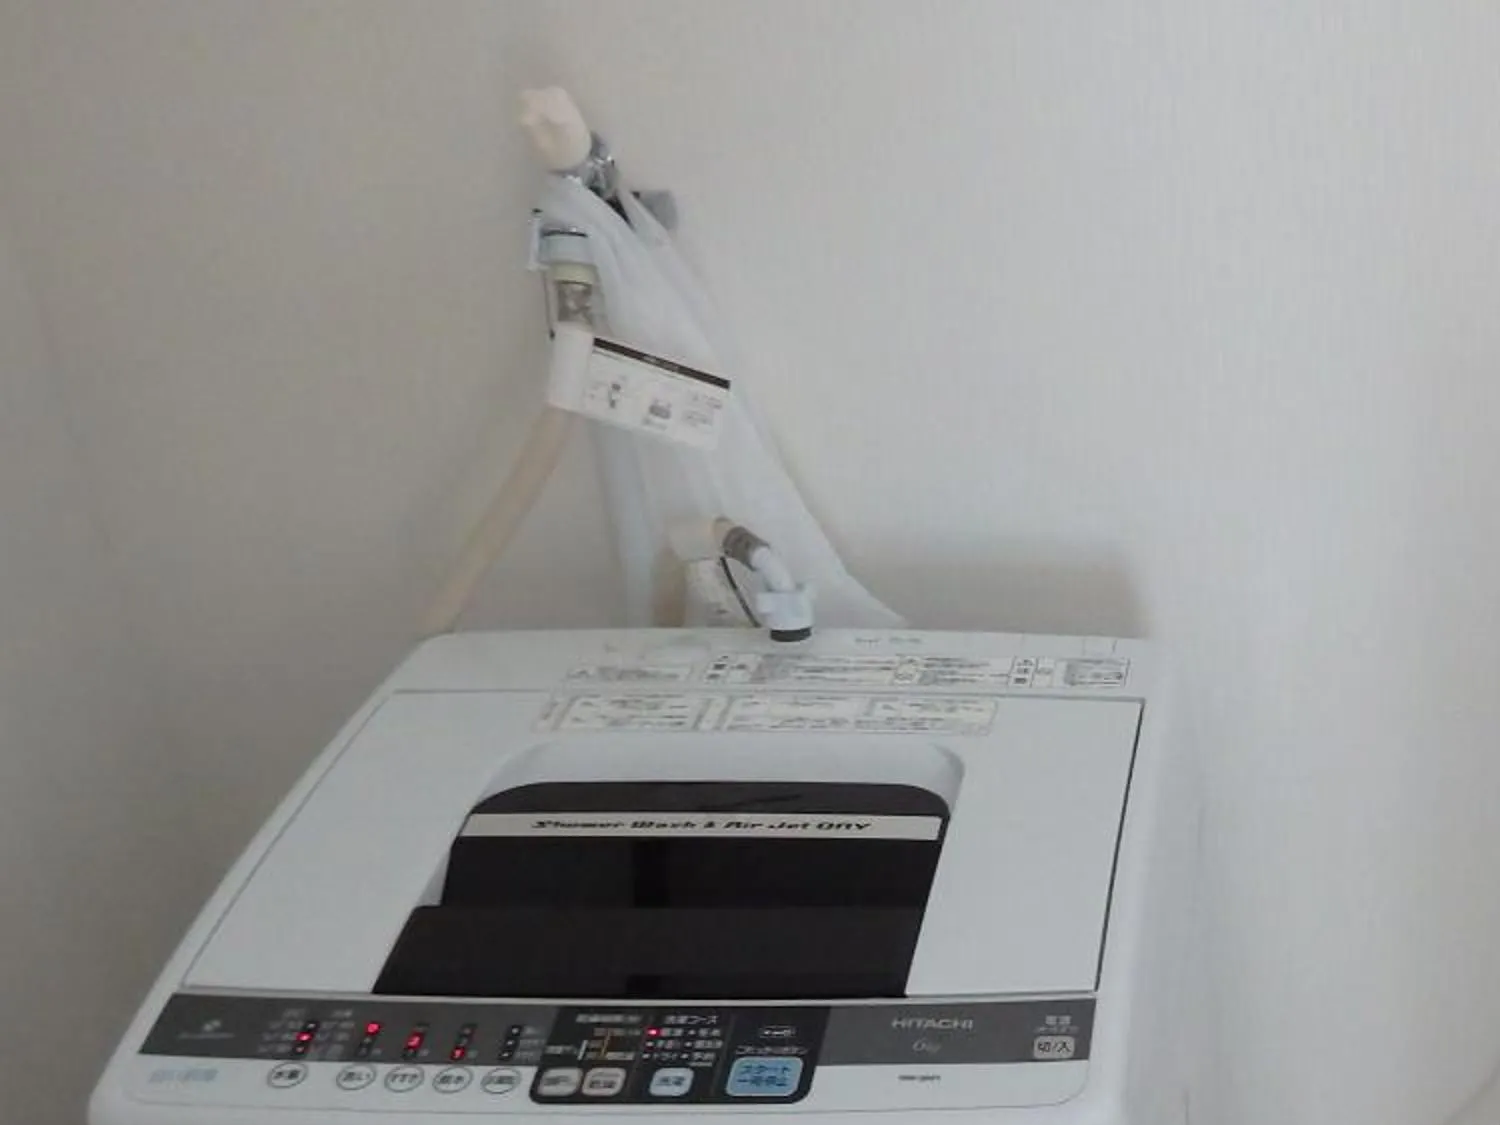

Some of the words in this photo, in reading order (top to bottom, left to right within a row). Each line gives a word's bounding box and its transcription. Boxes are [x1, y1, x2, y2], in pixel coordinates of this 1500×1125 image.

[531, 820, 625, 830] Shower
[630, 820, 697, 830] Wash
[723, 819, 764, 830] Air
[768, 820, 810, 831] Jet
[891, 1018, 974, 1030] HITACHI
